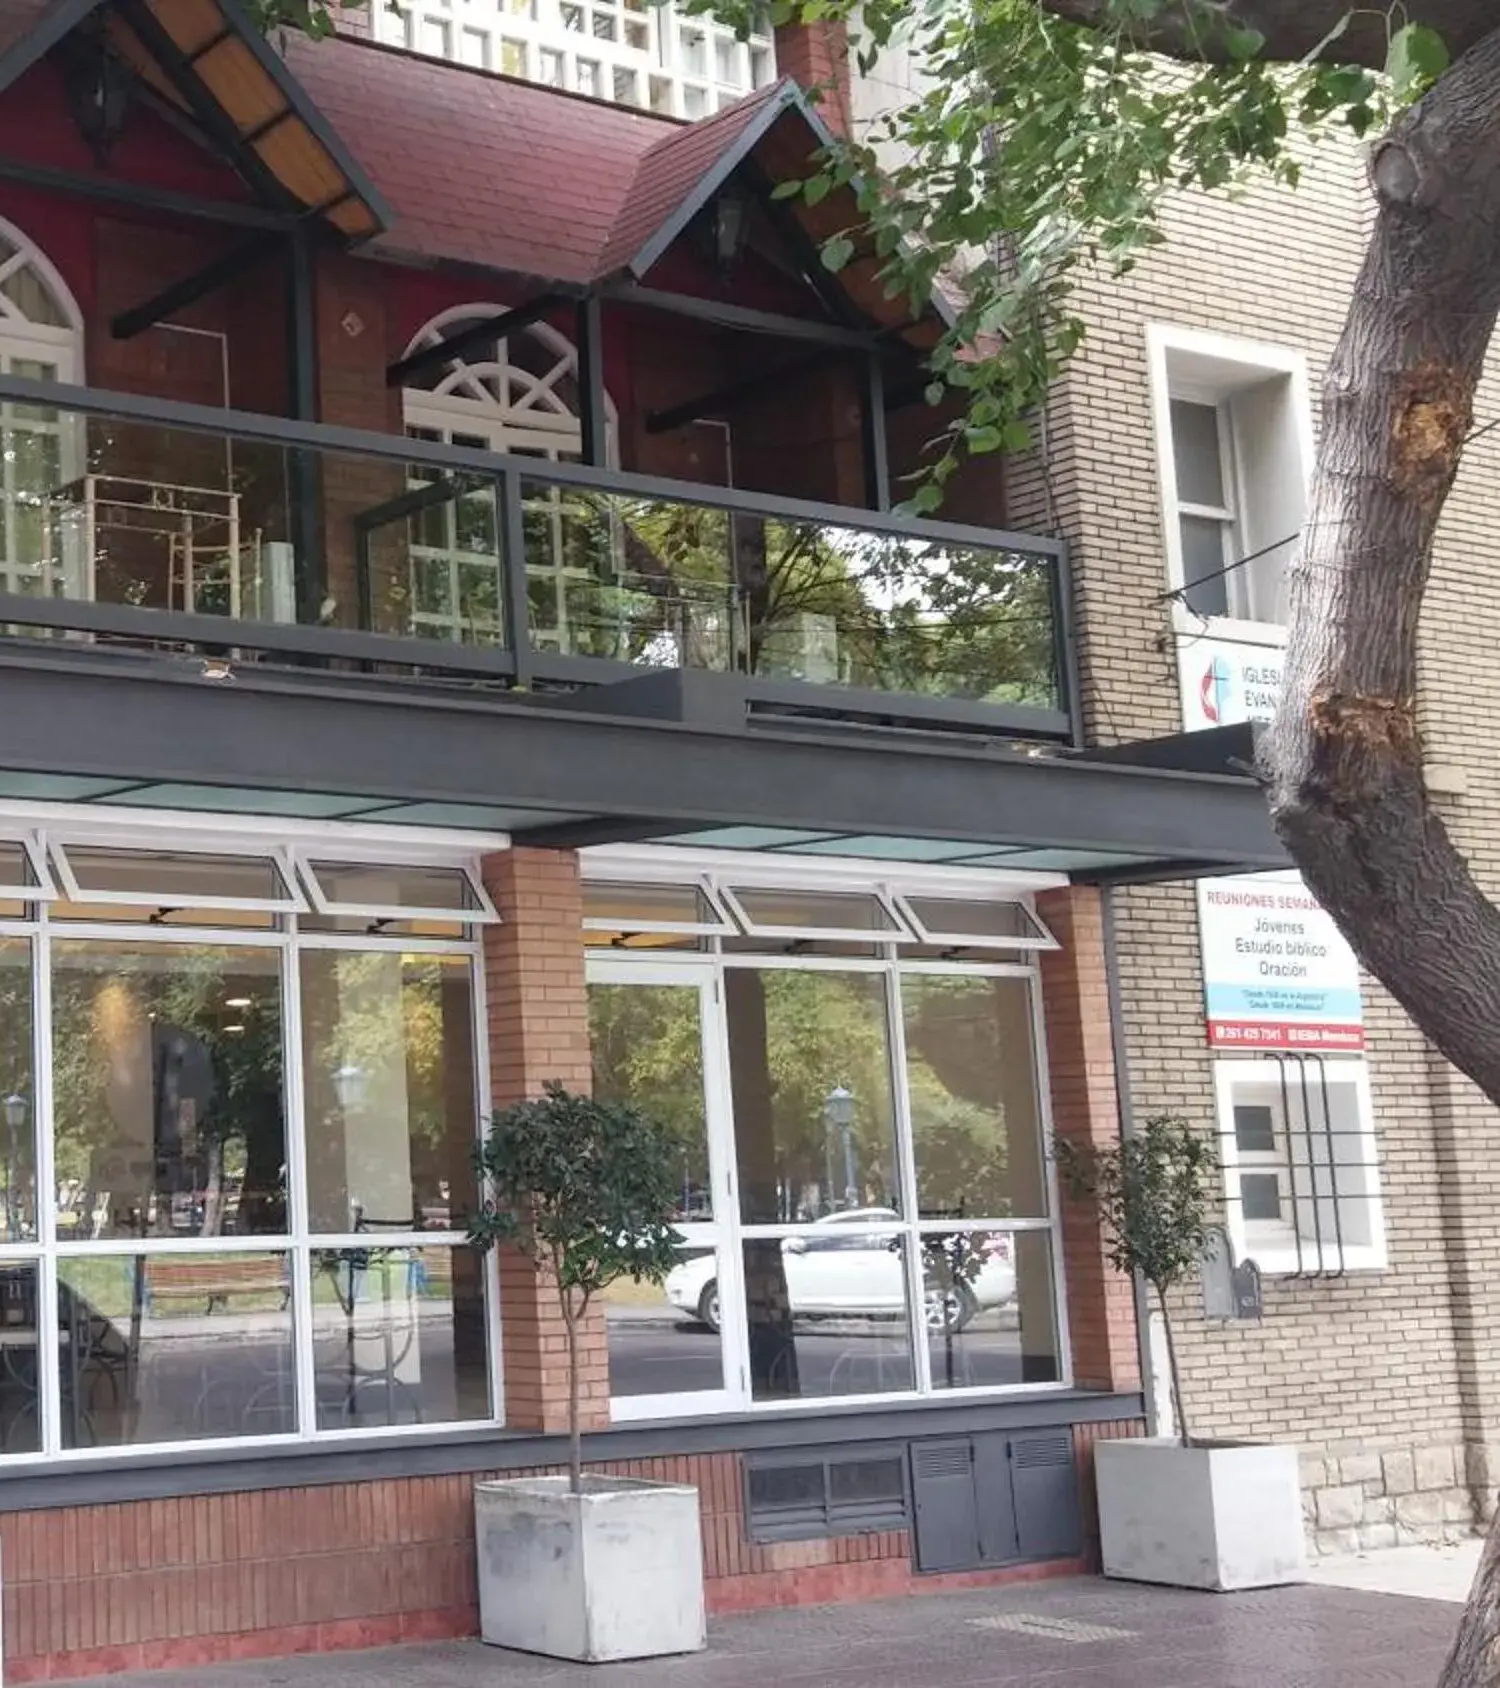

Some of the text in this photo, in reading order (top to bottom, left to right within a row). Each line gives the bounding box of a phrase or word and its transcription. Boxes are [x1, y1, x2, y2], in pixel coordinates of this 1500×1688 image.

[1207, 891, 1275, 909] REUNIONES
[1254, 917, 1304, 936] Jóvenes
[1235, 937, 1283, 956] Estudio
[1259, 961, 1307, 978] Oración
